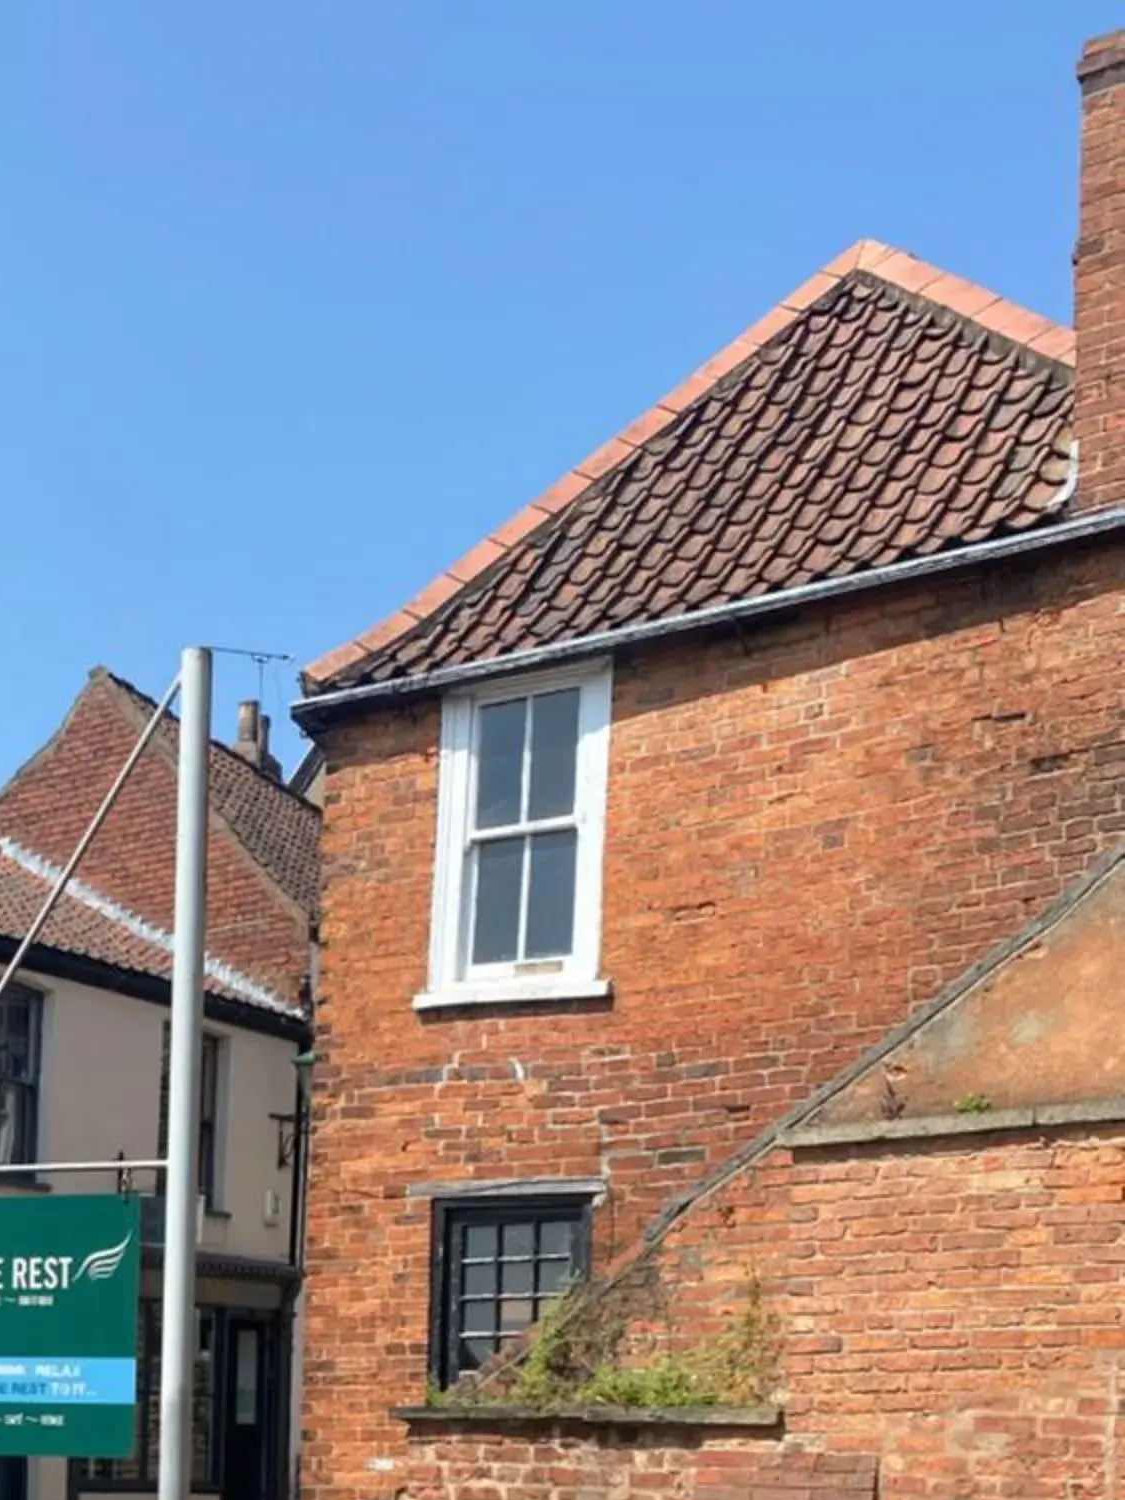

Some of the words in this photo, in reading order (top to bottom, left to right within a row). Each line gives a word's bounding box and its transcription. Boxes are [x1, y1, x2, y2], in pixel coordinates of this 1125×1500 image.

[11, 1256, 74, 1289] REST
[35, 1364, 81, 1378] RELAX
[11, 1381, 47, 1396] REST
[51, 1382, 71, 1397] TO
